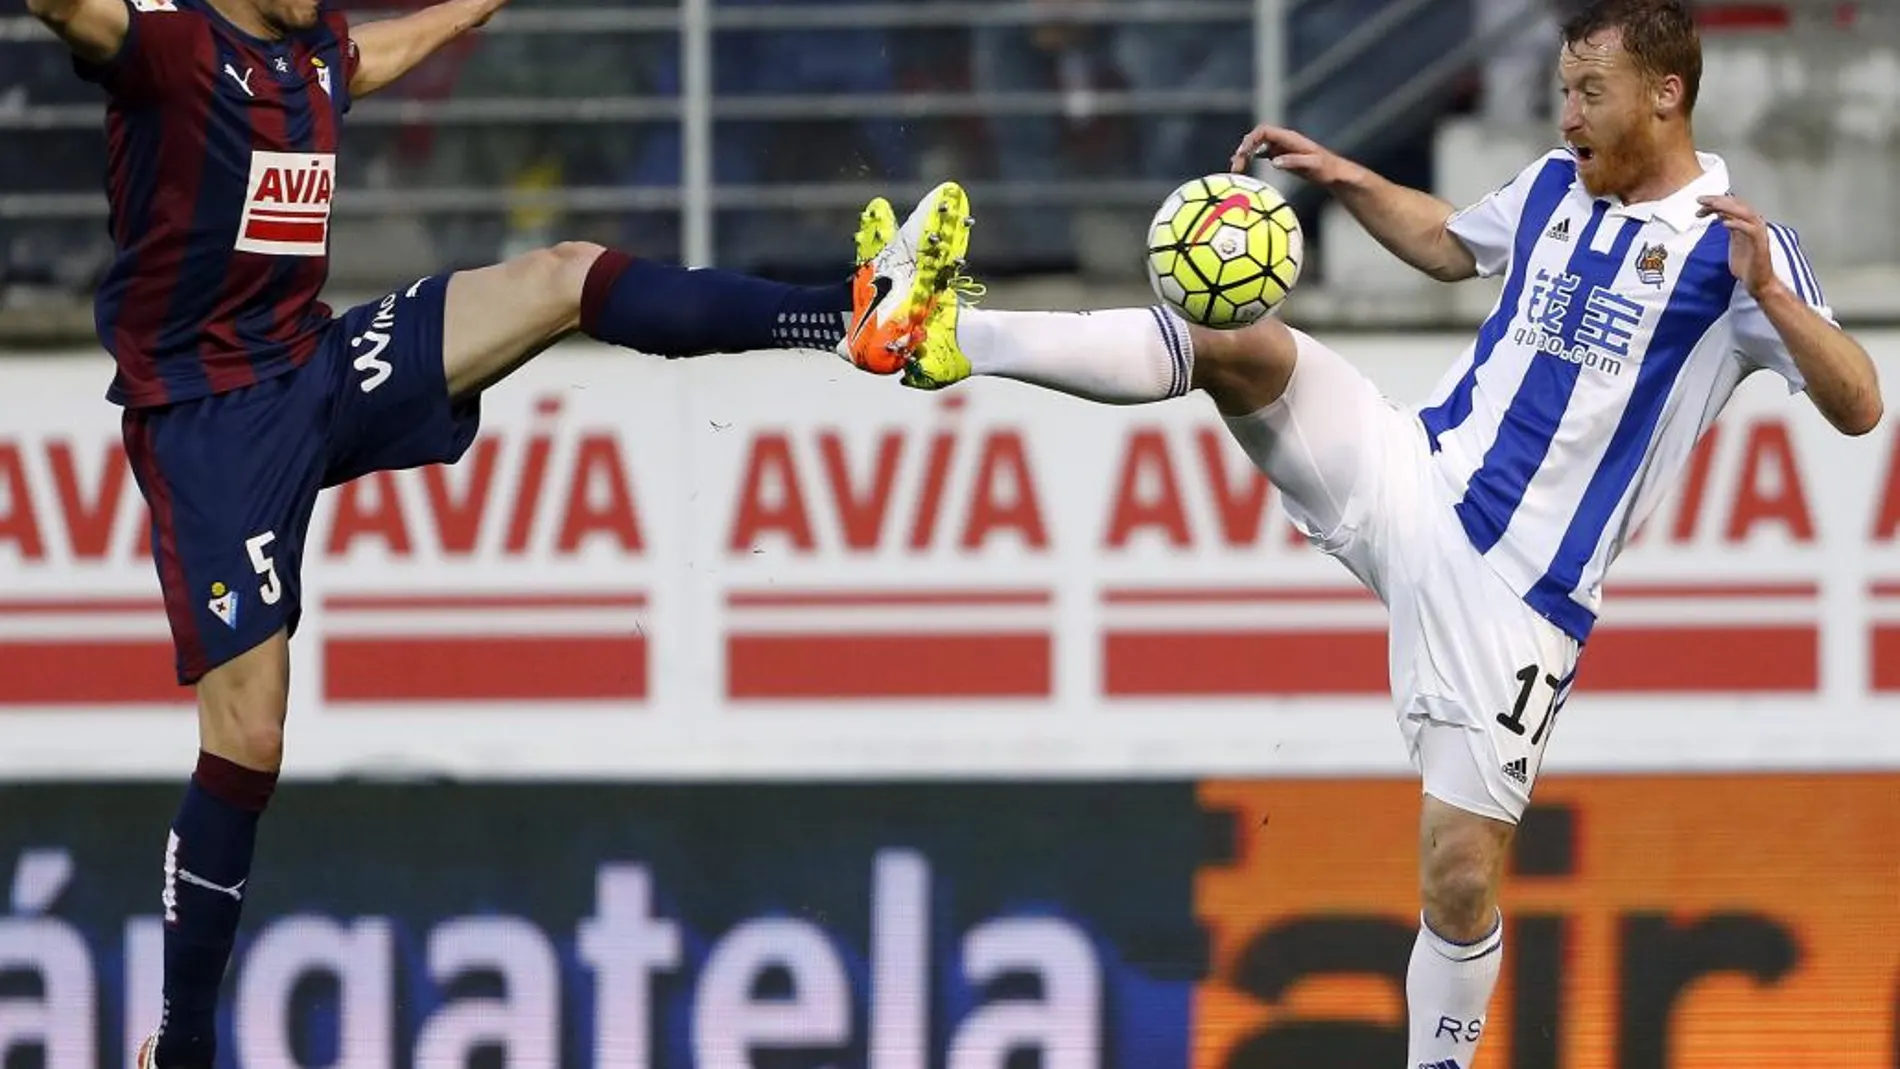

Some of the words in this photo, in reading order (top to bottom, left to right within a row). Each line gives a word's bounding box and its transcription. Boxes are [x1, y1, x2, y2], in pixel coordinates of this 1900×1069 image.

[1514, 327, 1622, 376] qbao.com
[728, 393, 1051, 553] AVIA
[245, 530, 281, 605] 5
[1496, 664, 1560, 745] 17
